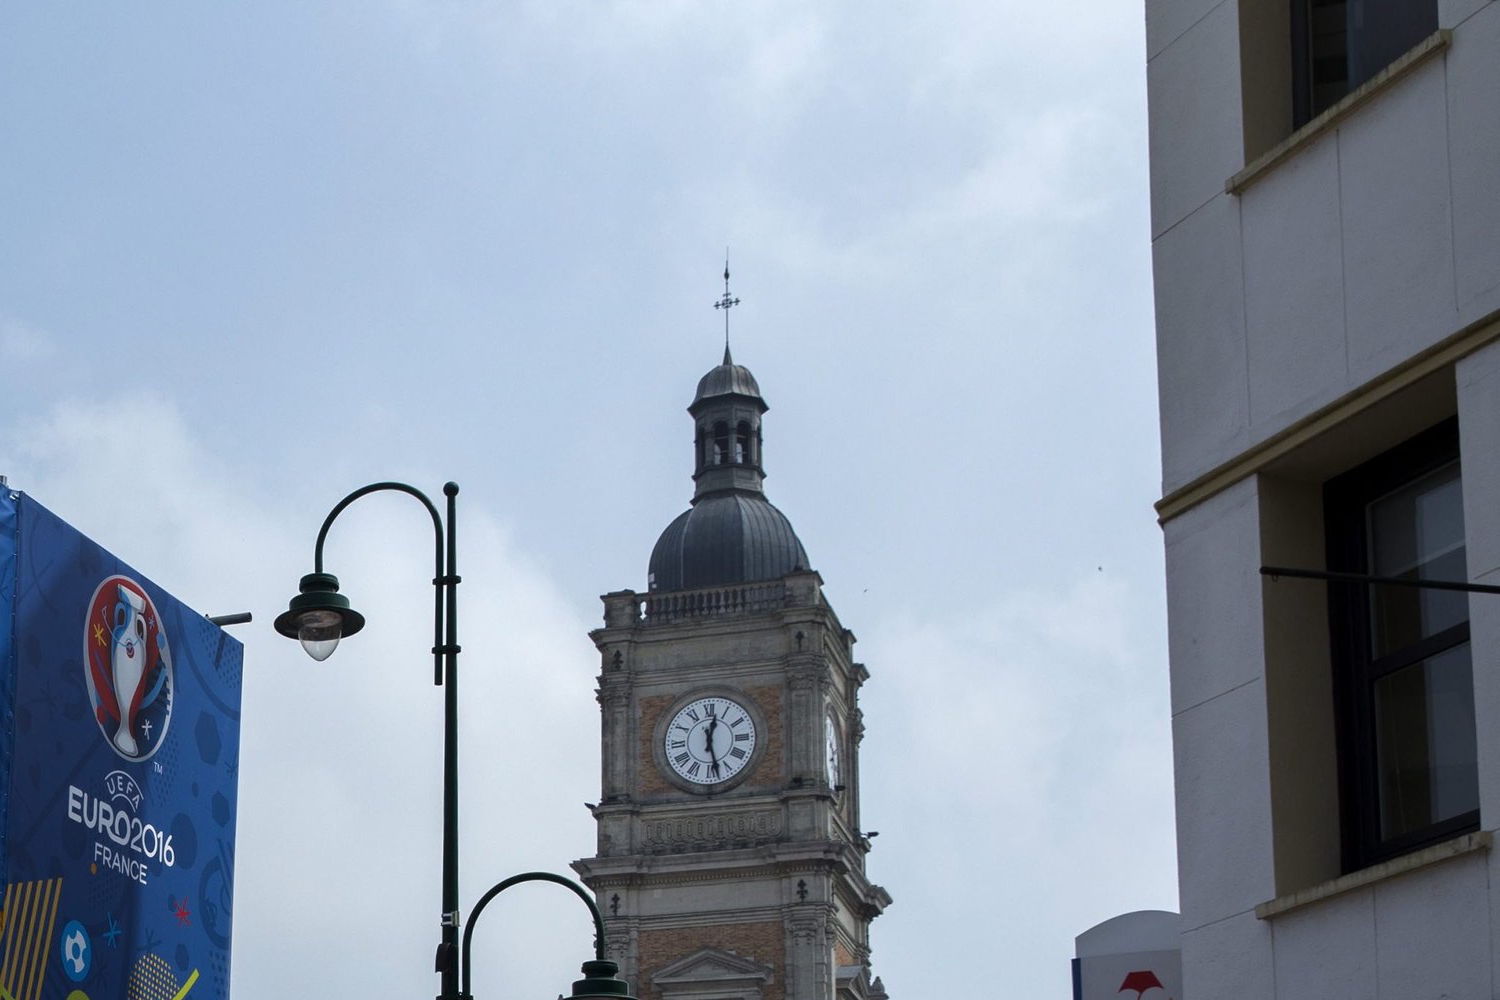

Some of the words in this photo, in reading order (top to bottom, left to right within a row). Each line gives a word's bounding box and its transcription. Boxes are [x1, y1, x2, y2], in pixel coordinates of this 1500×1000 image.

[107, 776, 140, 809] UEFA
[68, 785, 175, 867] EURO2016
[94, 842, 148, 885] FRANCE
